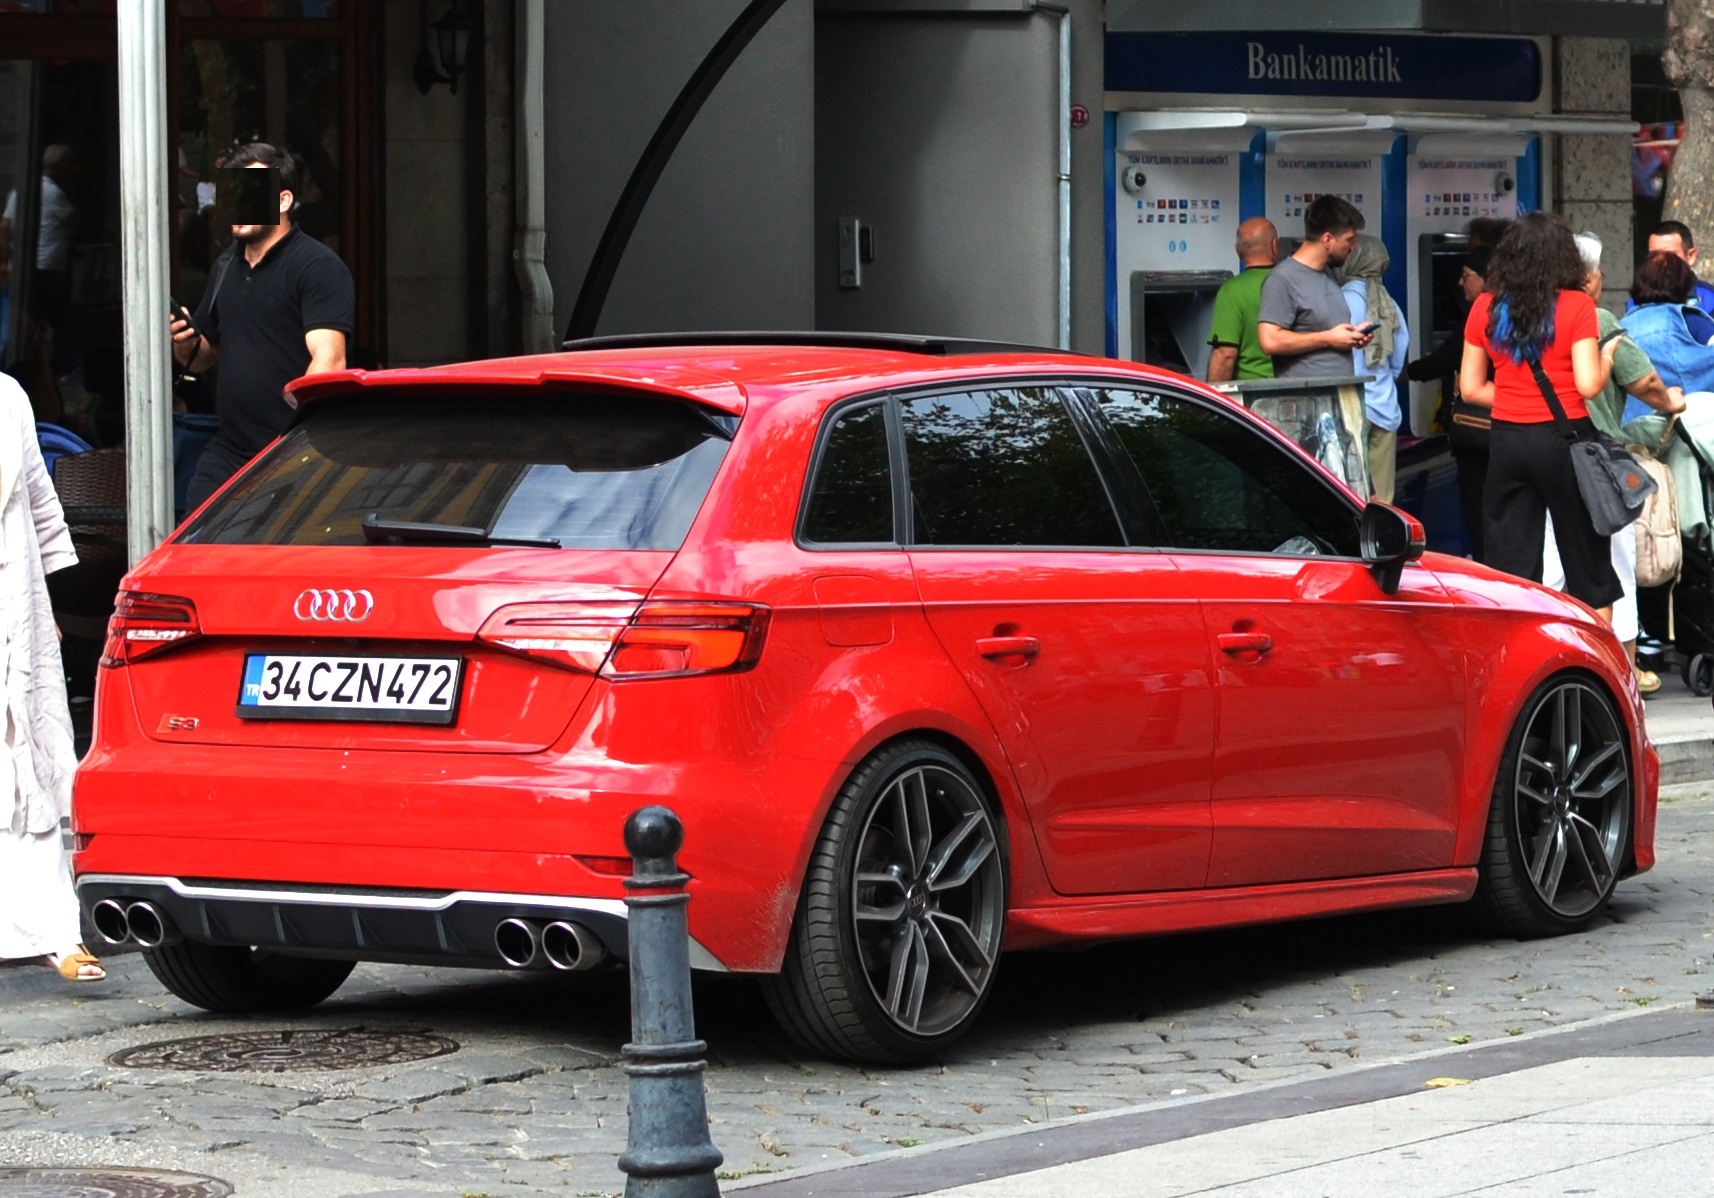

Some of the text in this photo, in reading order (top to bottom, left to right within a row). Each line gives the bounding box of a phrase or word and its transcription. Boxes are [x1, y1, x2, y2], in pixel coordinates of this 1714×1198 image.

[1247, 42, 1402, 82] Bankamatik
[246, 683, 260, 697] TR
[262, 660, 451, 705] 34CZN472
[168, 716, 200, 731] S3
